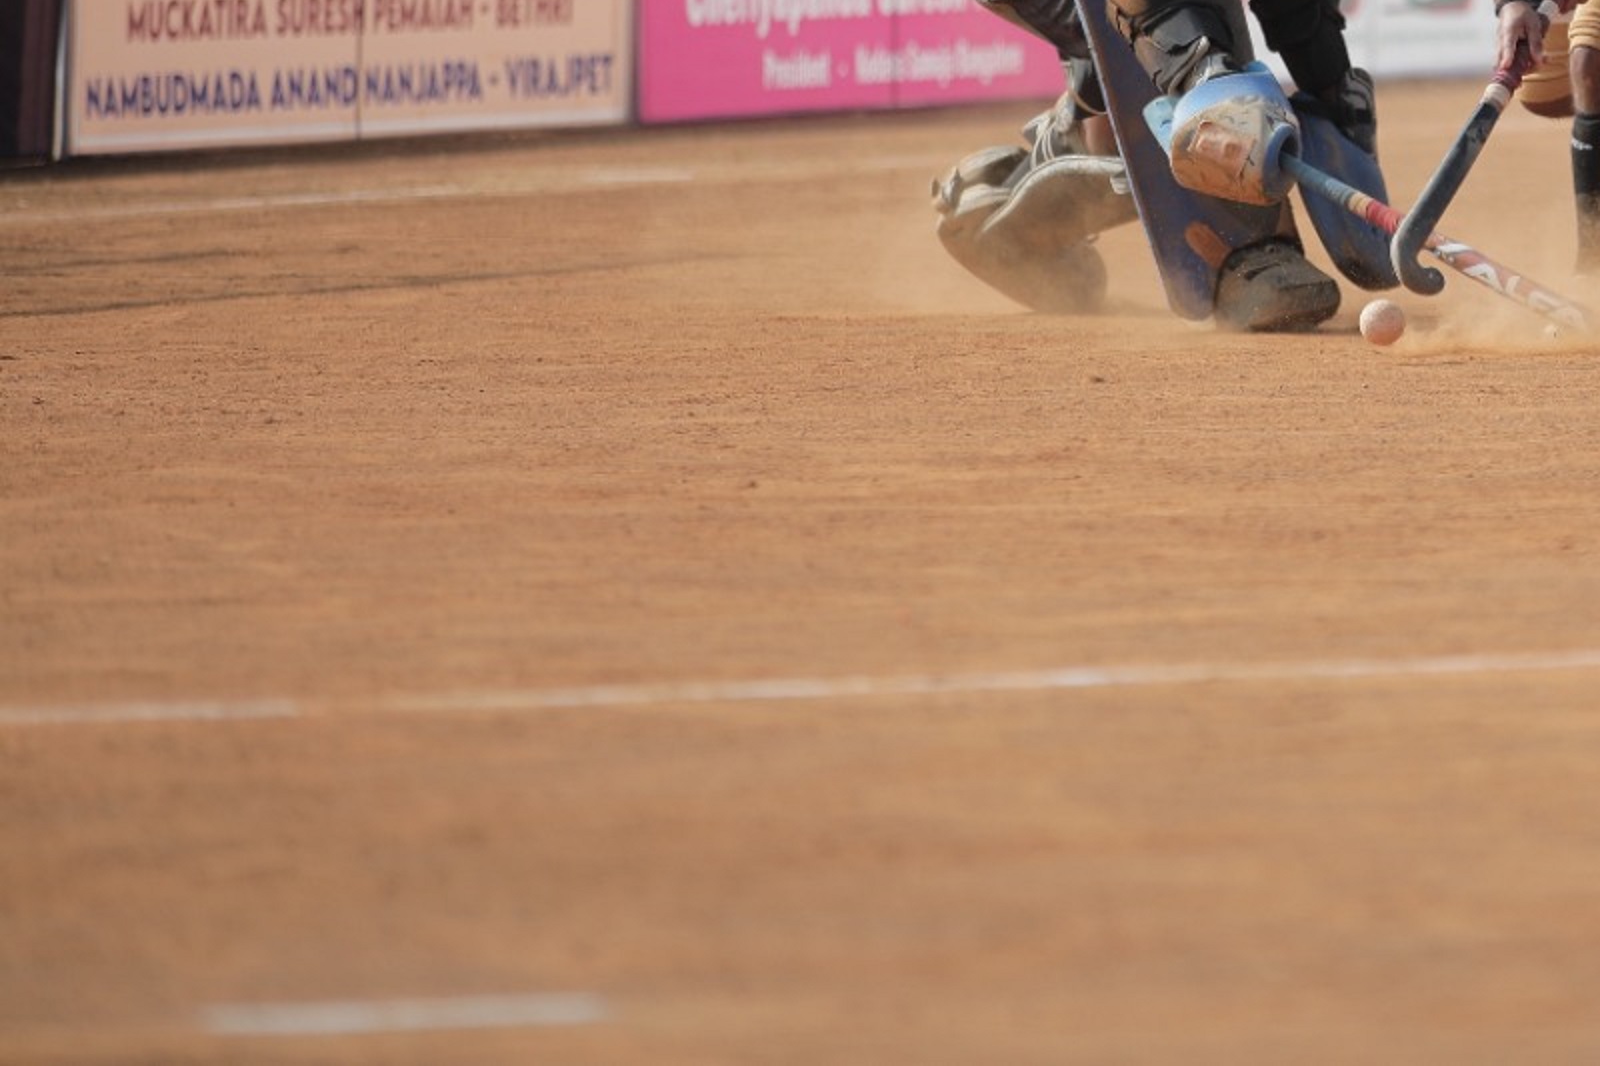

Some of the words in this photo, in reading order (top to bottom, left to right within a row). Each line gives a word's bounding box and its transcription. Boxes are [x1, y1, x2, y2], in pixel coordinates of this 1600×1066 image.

[85, 70, 262, 121] NAMBUDMADA
[270, 63, 358, 111] ANAND
[365, 60, 483, 107] NANJAPPA
[503, 54, 615, 101] VIRAJPET
